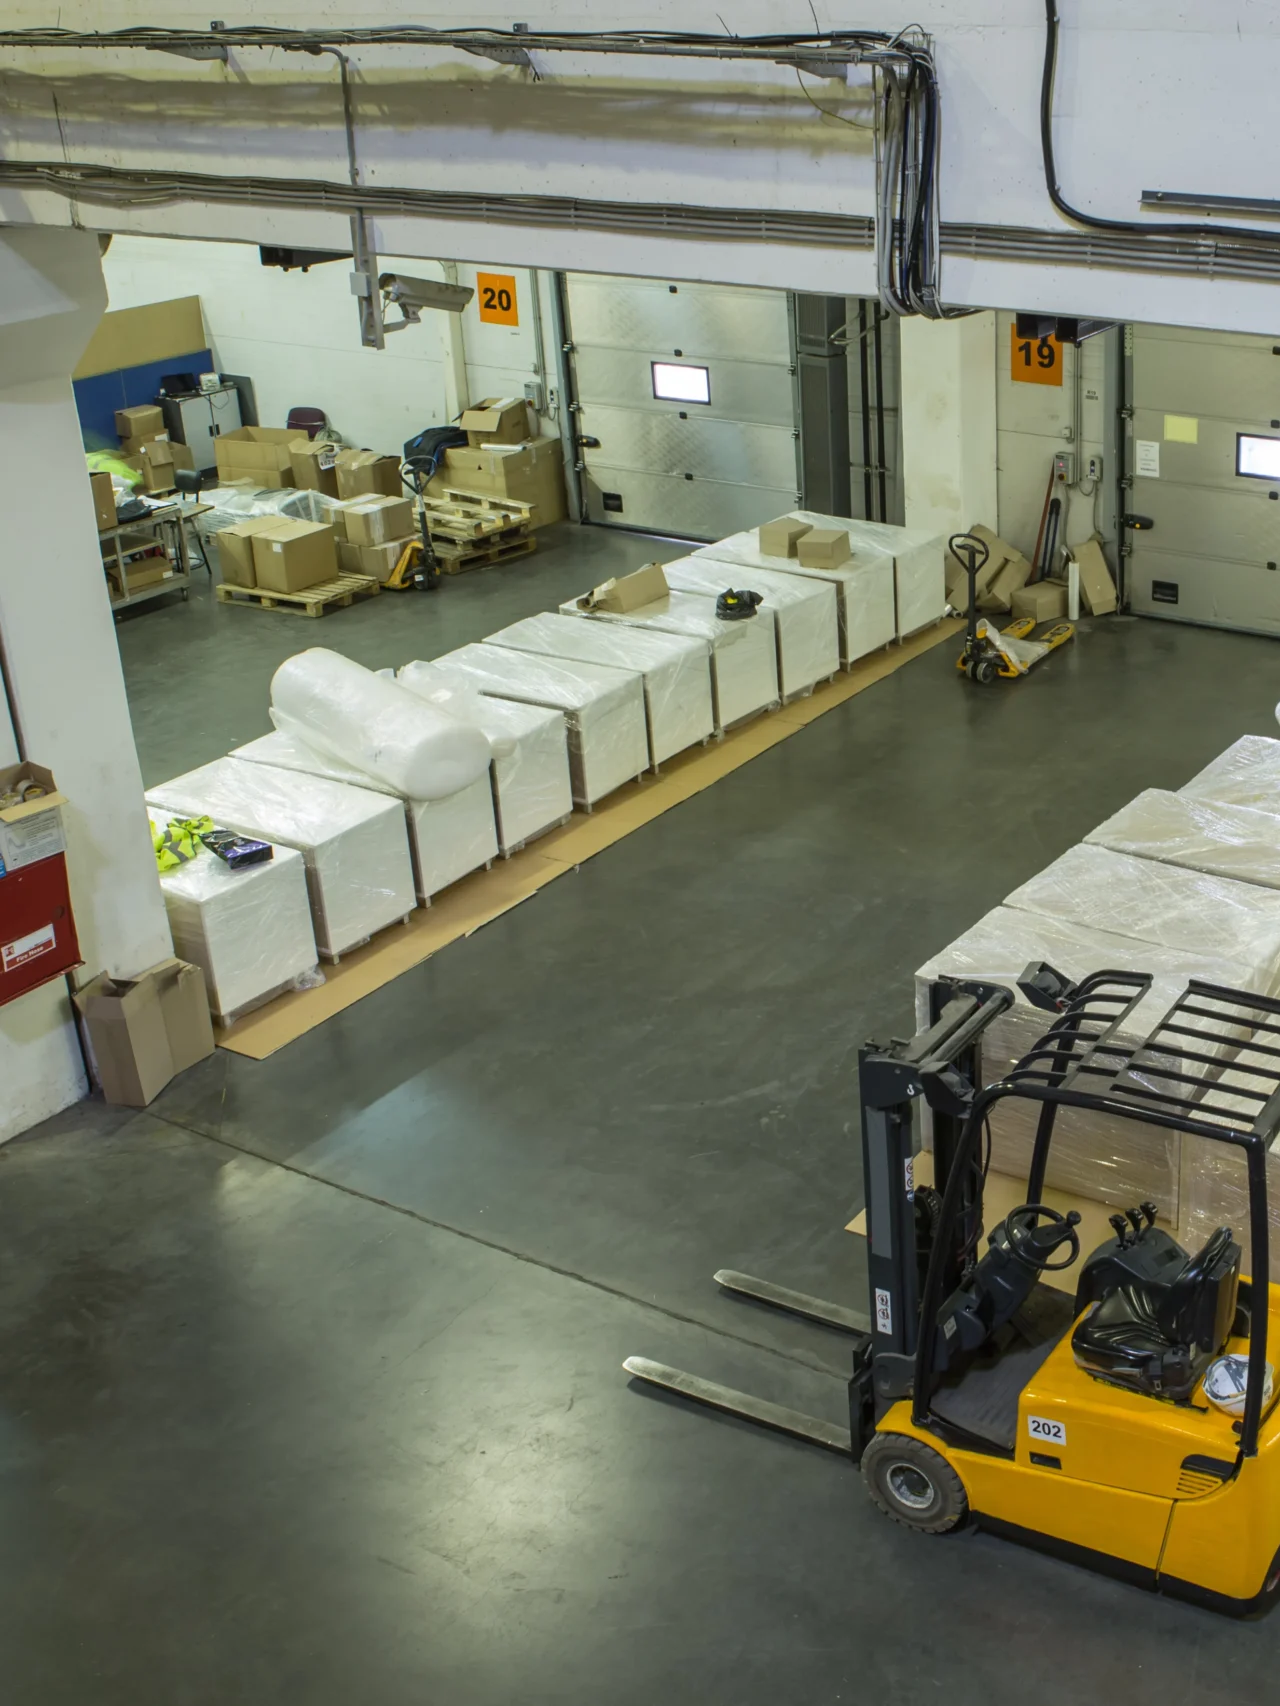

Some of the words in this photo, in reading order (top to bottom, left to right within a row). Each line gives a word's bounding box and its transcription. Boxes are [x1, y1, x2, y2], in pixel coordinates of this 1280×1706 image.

[483, 287, 511, 311] 20
[1018, 341, 1055, 368] 19
[1032, 1420, 1062, 1438] 202
